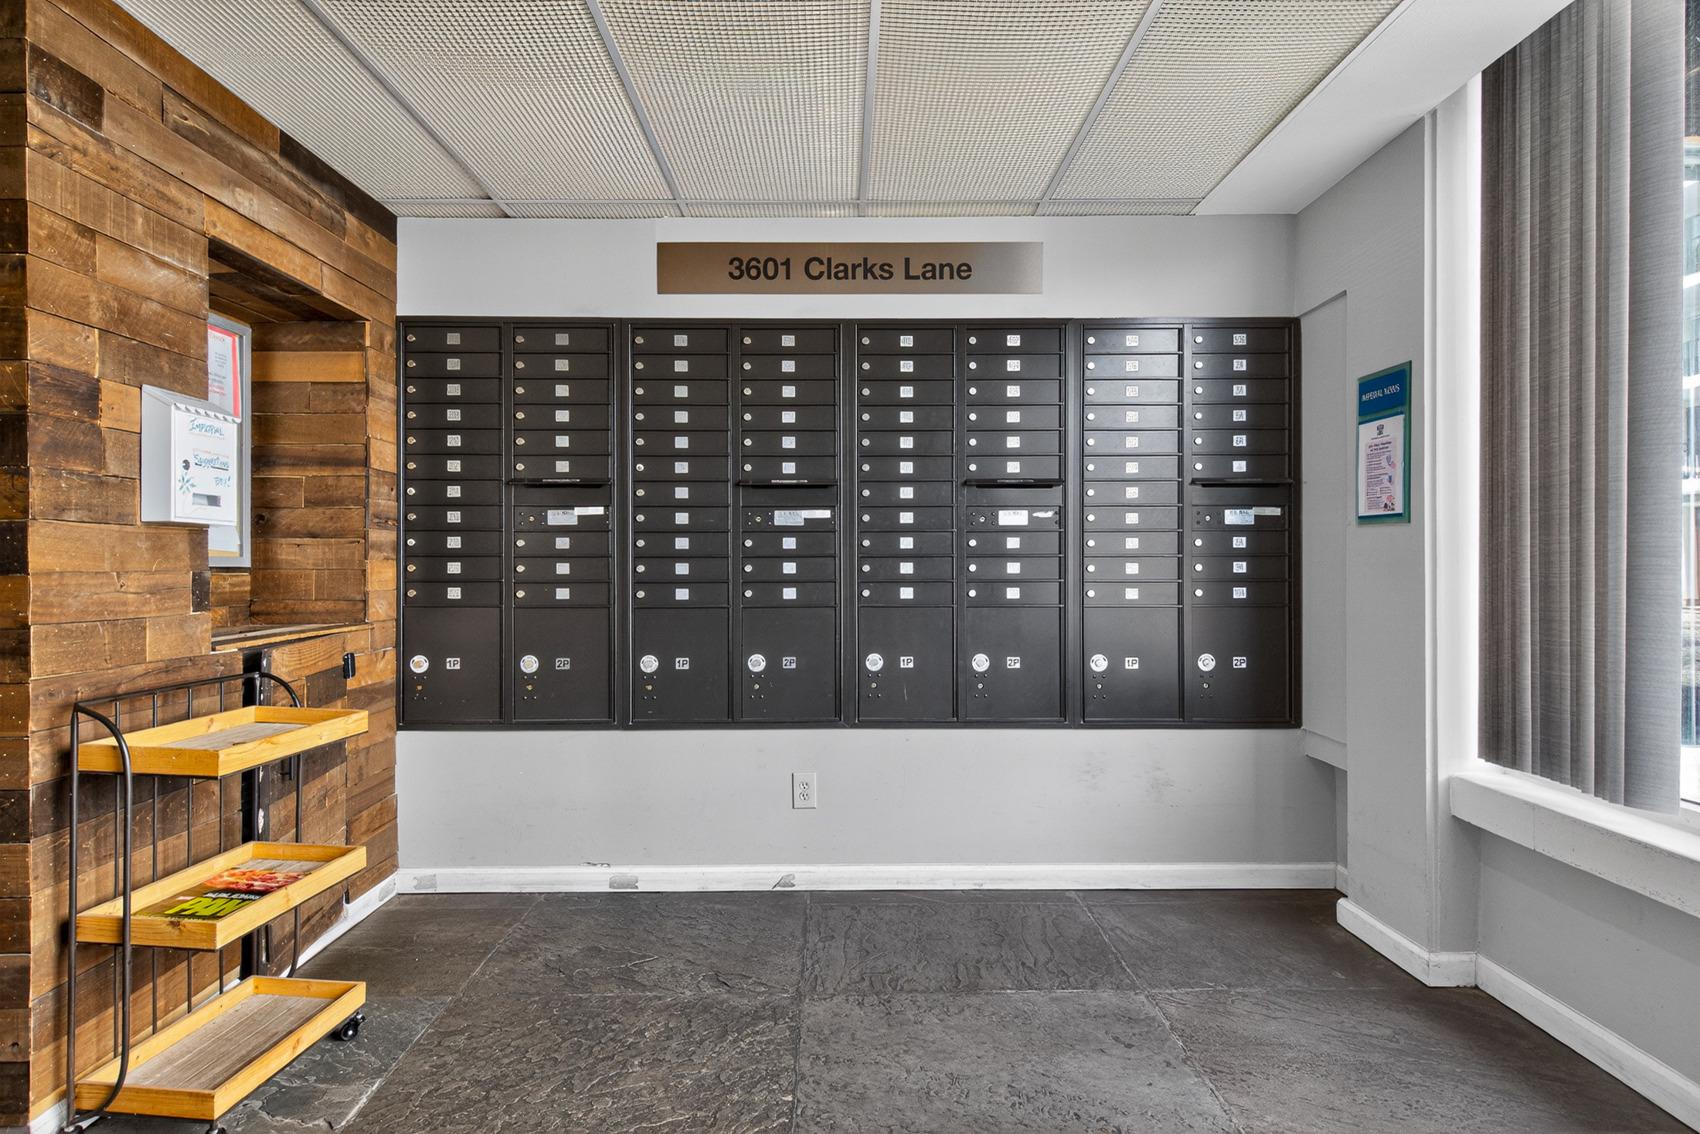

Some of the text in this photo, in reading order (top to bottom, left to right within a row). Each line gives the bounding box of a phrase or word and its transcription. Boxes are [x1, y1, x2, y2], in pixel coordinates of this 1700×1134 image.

[728, 257, 973, 281] 3601 Clarks Lane
[1383, 384, 1401, 395] NEWS
[447, 660, 459, 668] 1P
[557, 660, 569, 669] 2P
[676, 660, 688, 668] 1P
[784, 659, 796, 667] 2P
[902, 658, 913, 667] 1P
[1008, 659, 1020, 667] 2P
[1127, 659, 1138, 667] 1P
[1234, 658, 1246, 667] 2P
